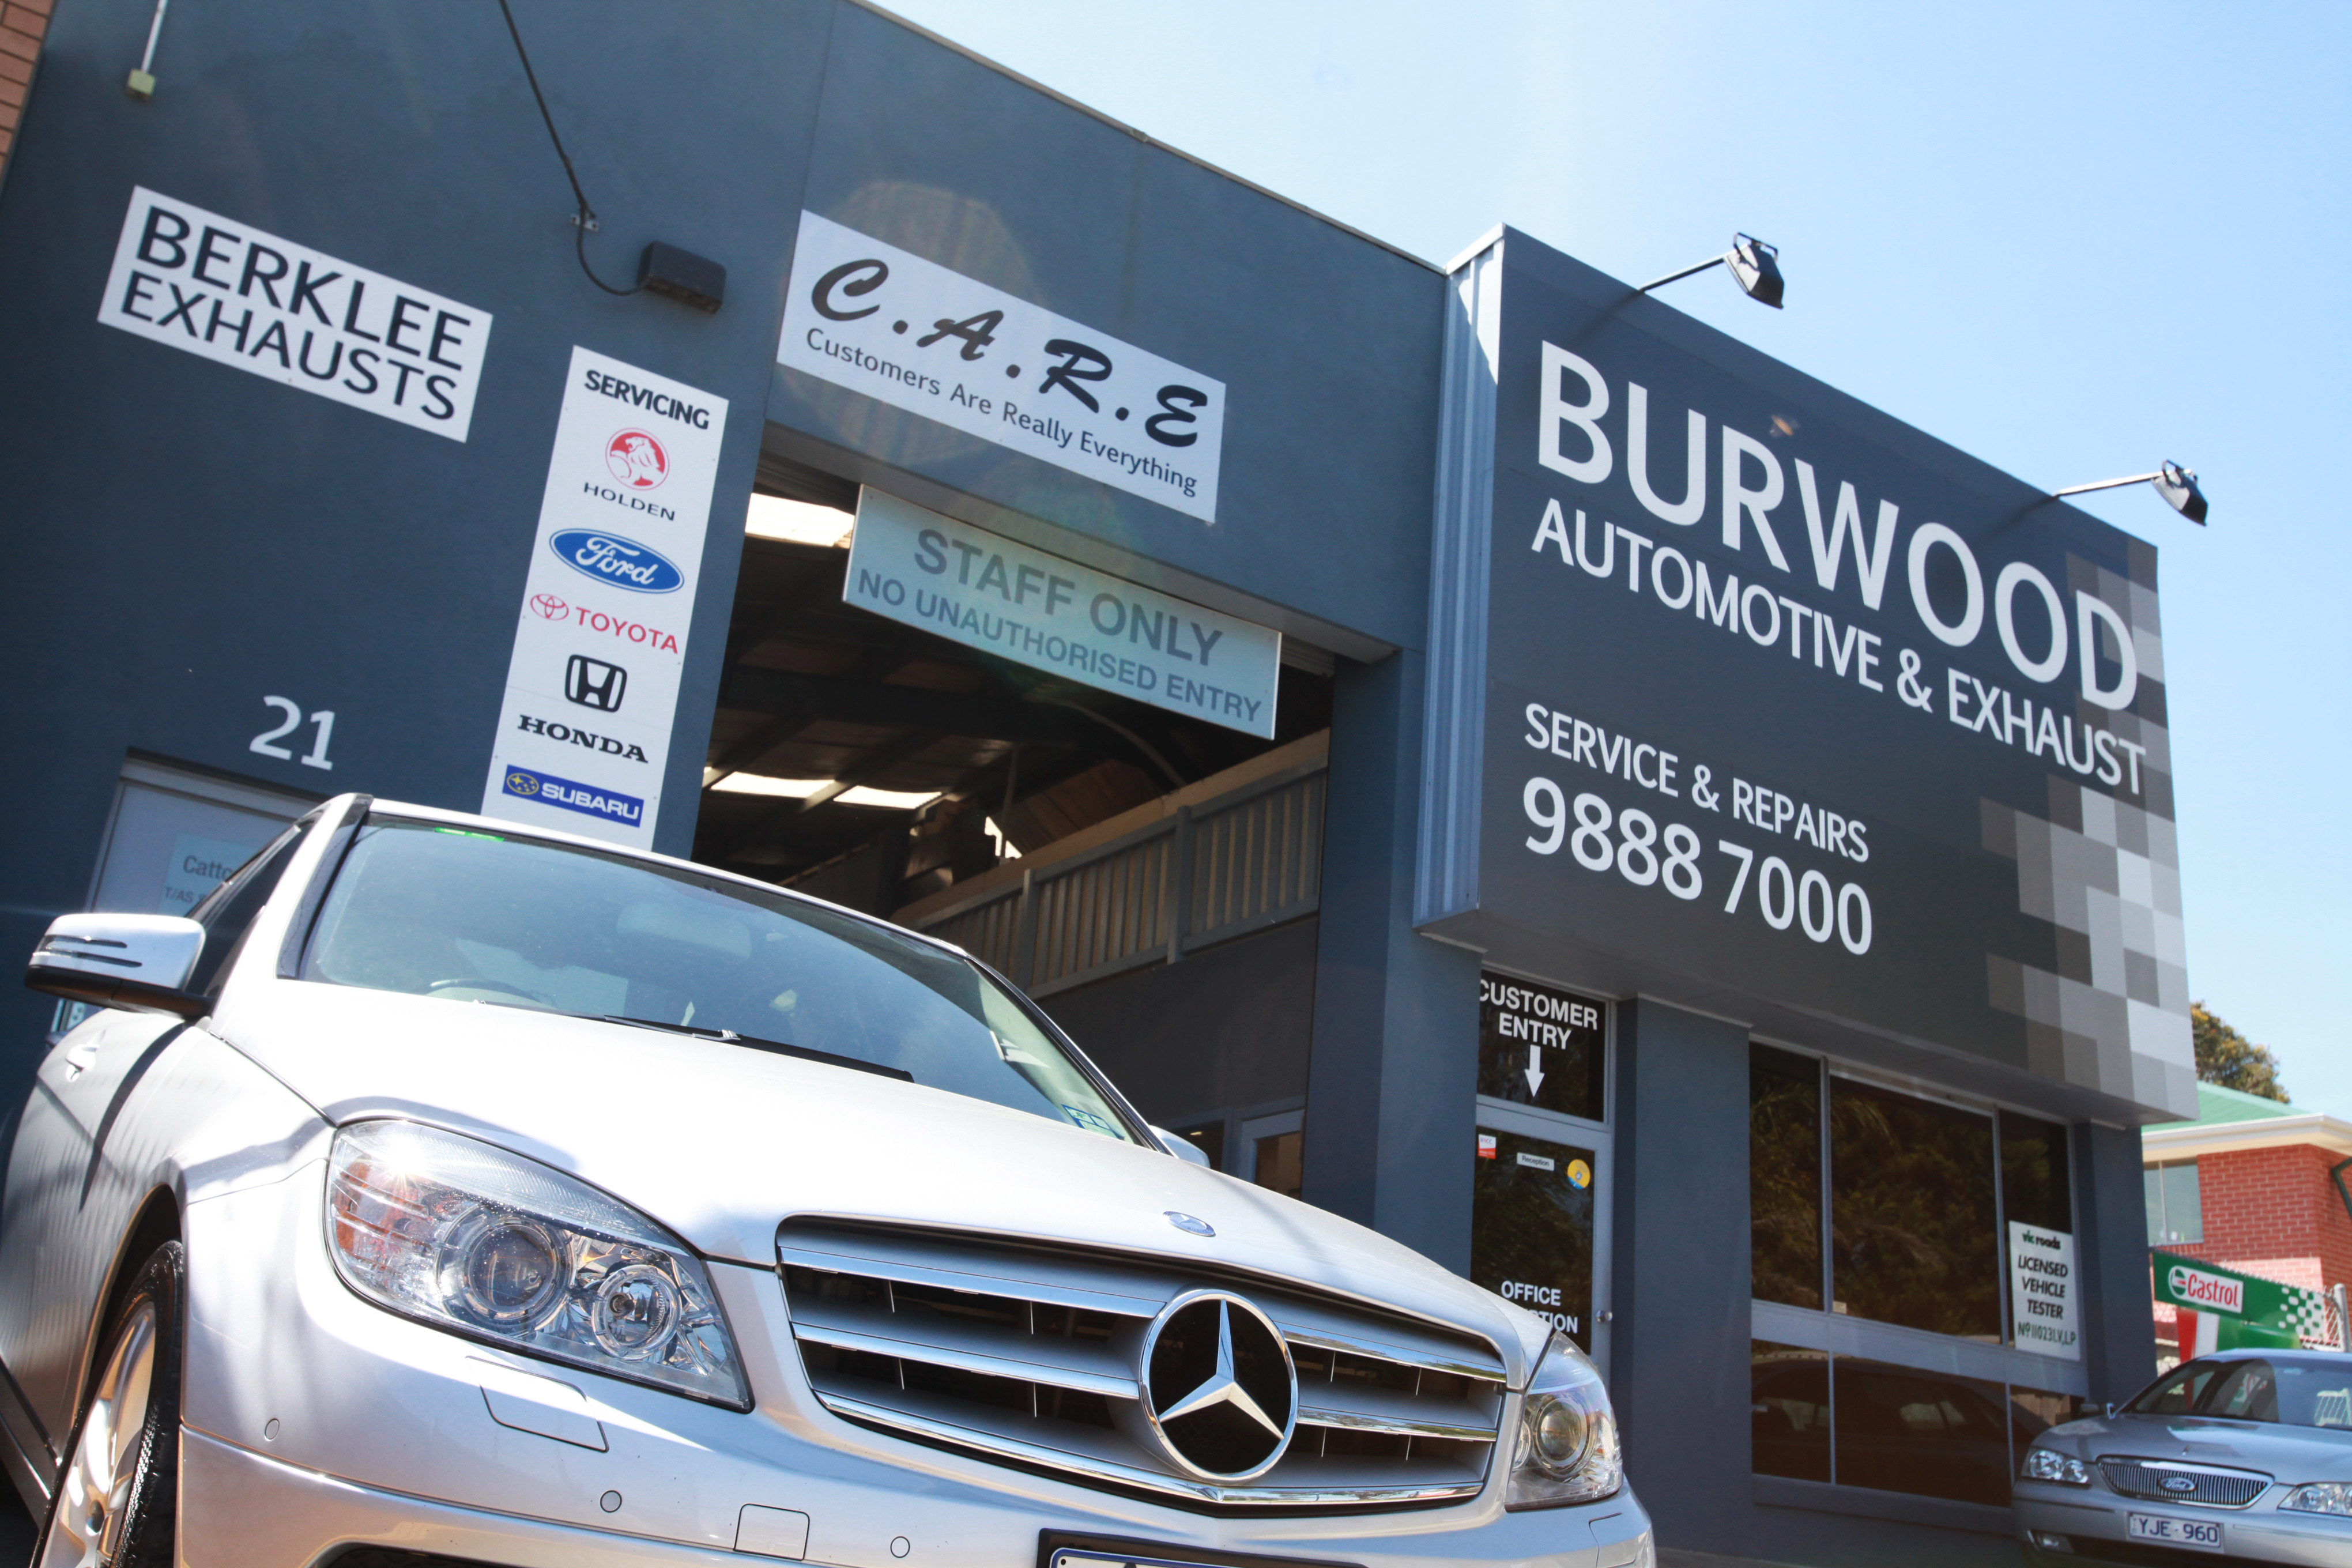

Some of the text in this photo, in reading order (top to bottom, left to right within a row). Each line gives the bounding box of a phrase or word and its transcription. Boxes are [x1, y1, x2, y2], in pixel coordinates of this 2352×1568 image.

[136, 205, 472, 372] BERKLEE
[120, 270, 457, 421] EXHAUSTS
[585, 370, 710, 429] SERVICING
[806, 327, 1197, 498] Customers Are Really Everything
[583, 483, 675, 521] HOLDEN
[1538, 340, 2138, 710] BURWOOD
[575, 537, 659, 585] Ford
[914, 529, 1223, 666] STAFF ONLY
[576, 607, 679, 654] TOYOTA
[858, 568, 1262, 722] NO UNAUTHORISED ENTRY
[1531, 498, 2146, 795] AUTOMOTIVE & EXHAUST
[249, 695, 336, 771] 21
[517, 714, 649, 763] HONDA
[541, 782, 639, 820] SUBARU
[1525, 703, 1869, 863] SERVICE & REPAIRS
[1524, 777, 1872, 955] 9888 7000
[1480, 979, 1598, 1030] CUSTOMER
[1499, 1012, 1573, 1050] ENTRY
[2018, 1254, 2068, 1278] LICENSED
[2022, 1276, 2065, 1298] VEHICLE
[2188, 1274, 2238, 1307] Castrol
[1501, 1280, 1562, 1306] OFFICE
[2027, 1299, 2063, 1320] TESTER
